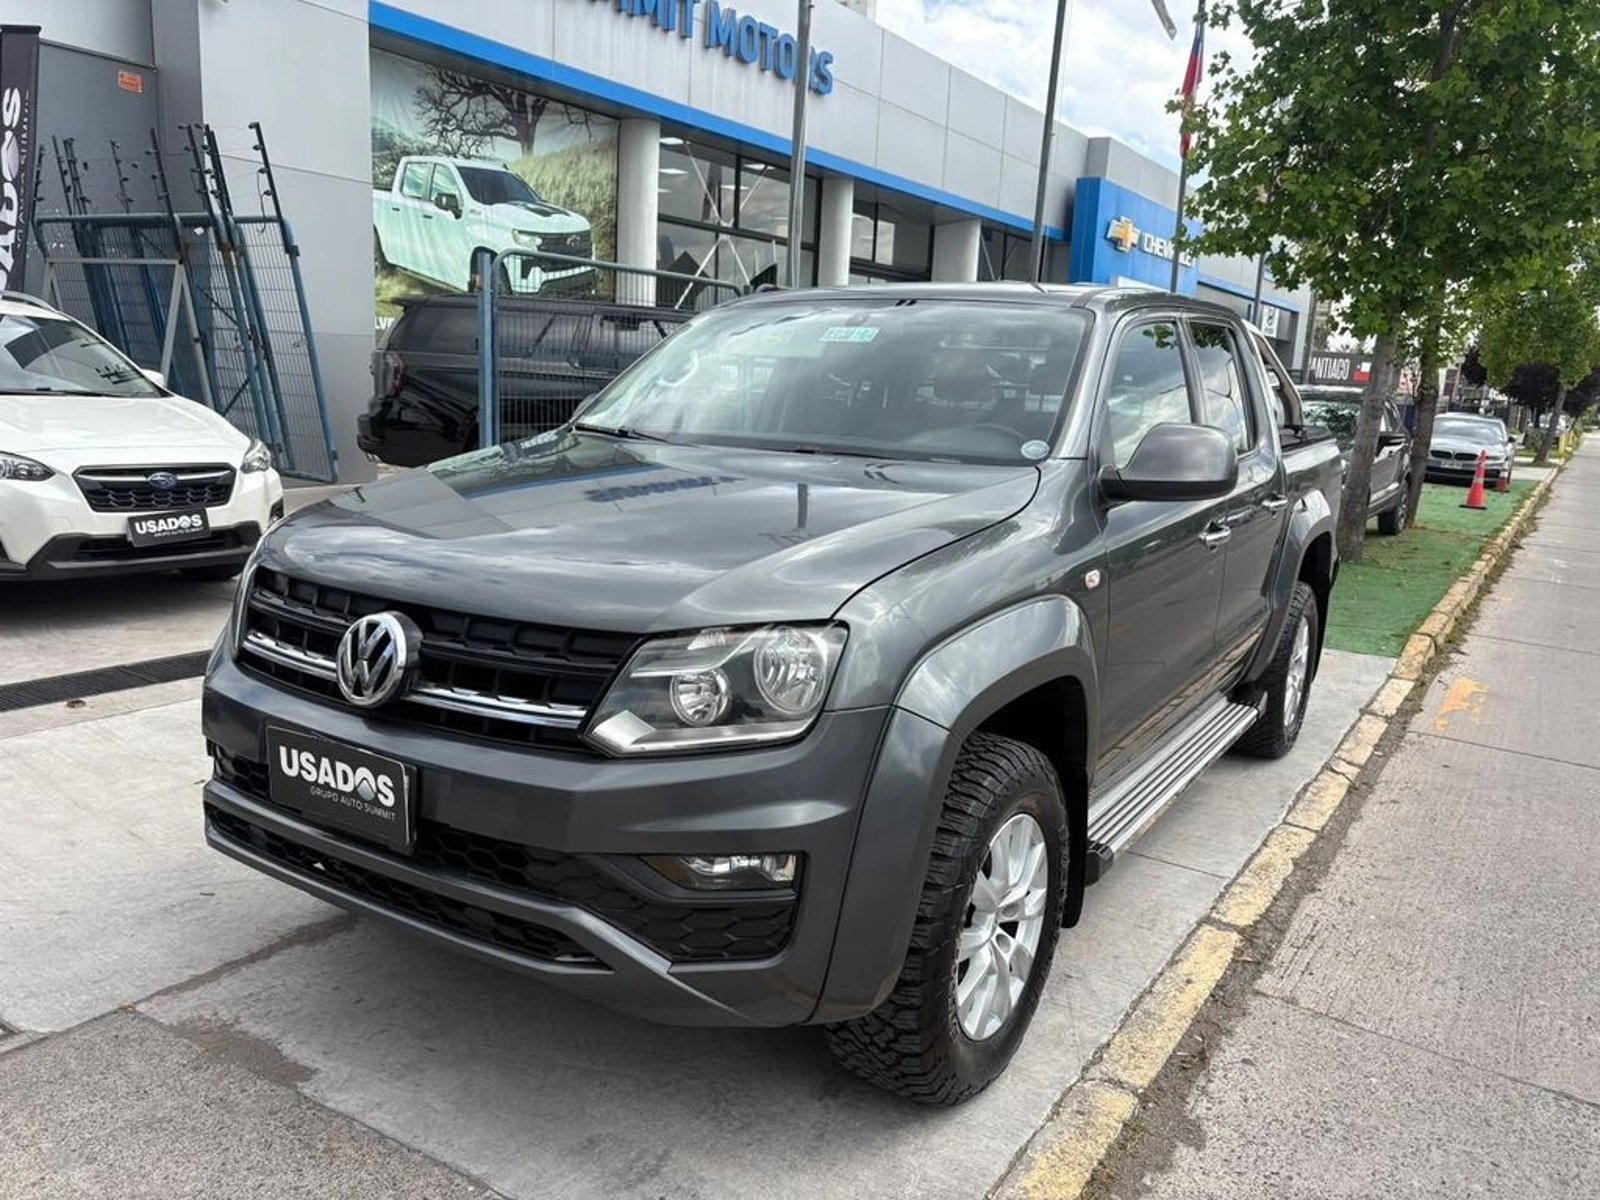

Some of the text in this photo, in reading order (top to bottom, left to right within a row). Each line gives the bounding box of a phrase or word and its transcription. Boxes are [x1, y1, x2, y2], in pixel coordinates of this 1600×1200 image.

[1143, 232, 1197, 268] CHEVLE
[134, 513, 203, 535] USADOS
[279, 745, 395, 808] USADOS
